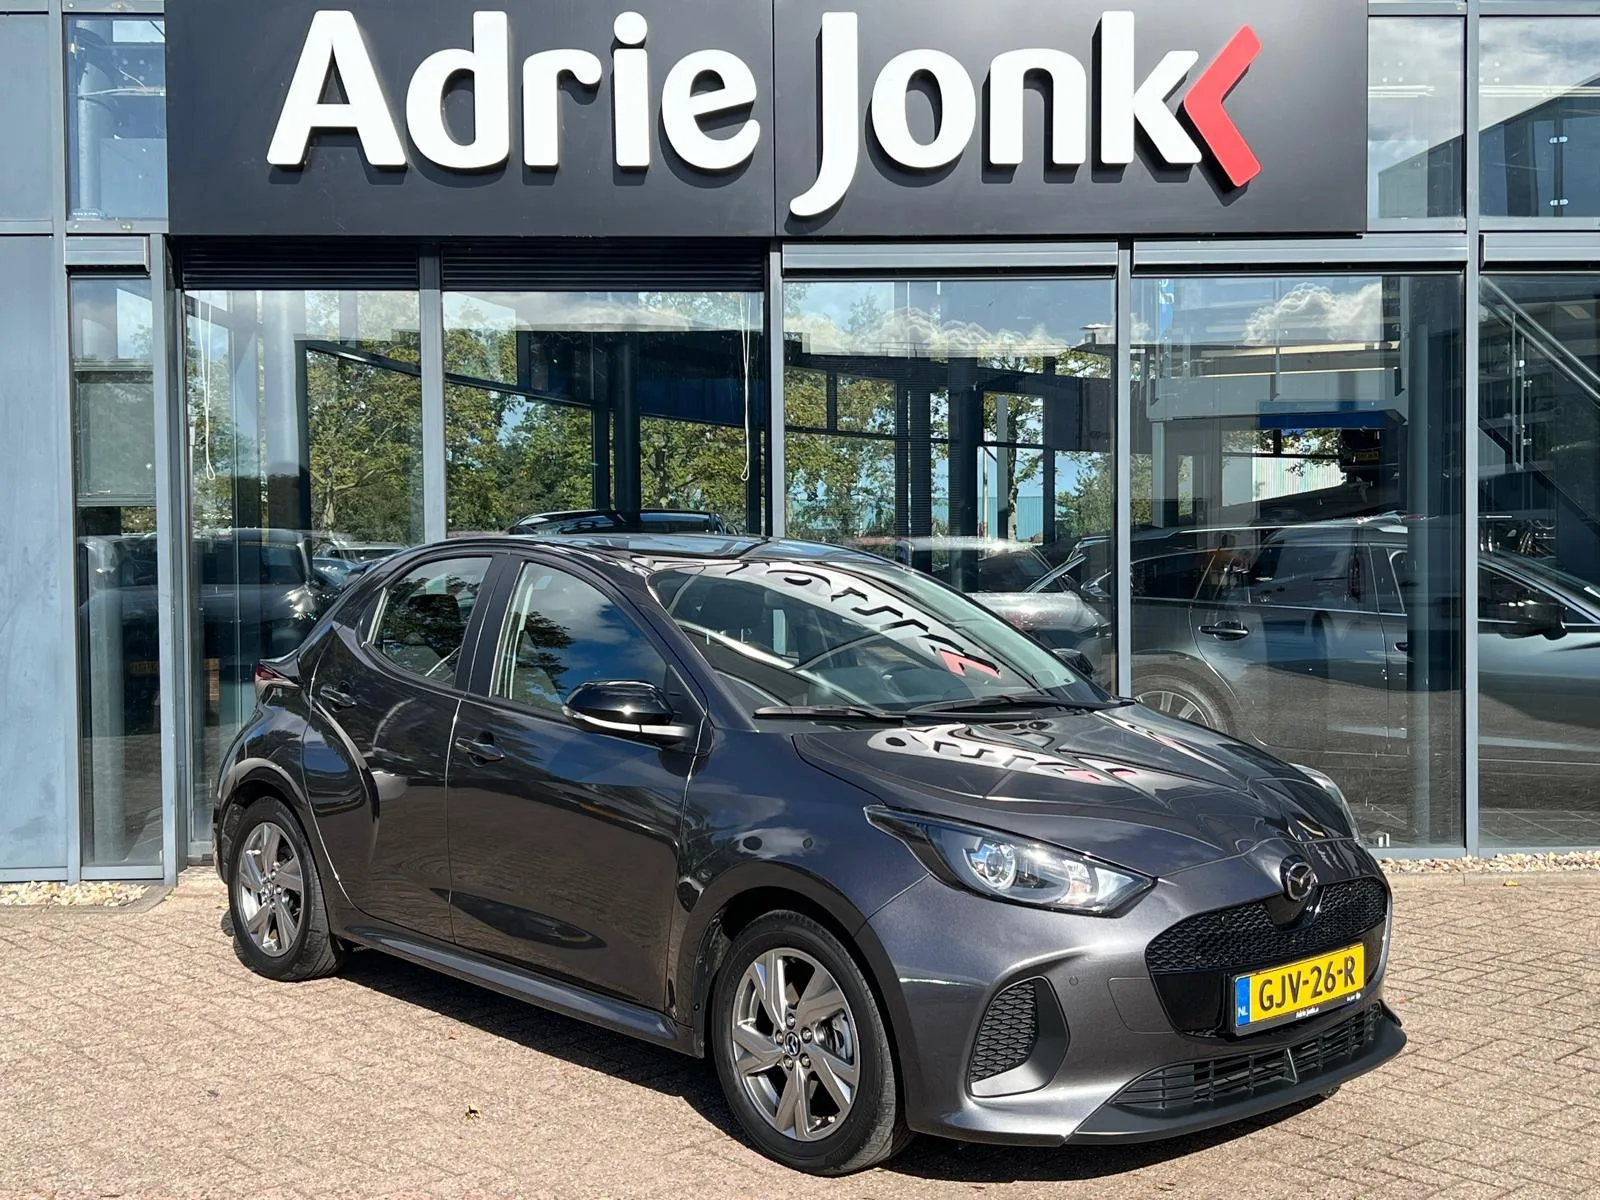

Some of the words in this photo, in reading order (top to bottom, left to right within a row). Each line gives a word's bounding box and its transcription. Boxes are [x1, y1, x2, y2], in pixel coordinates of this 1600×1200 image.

[266, 10, 761, 169] Adrie
[790, 10, 1202, 216] Jonk
[1237, 1006, 1249, 1018] NL
[1259, 956, 1356, 1012] GJV-26-R
